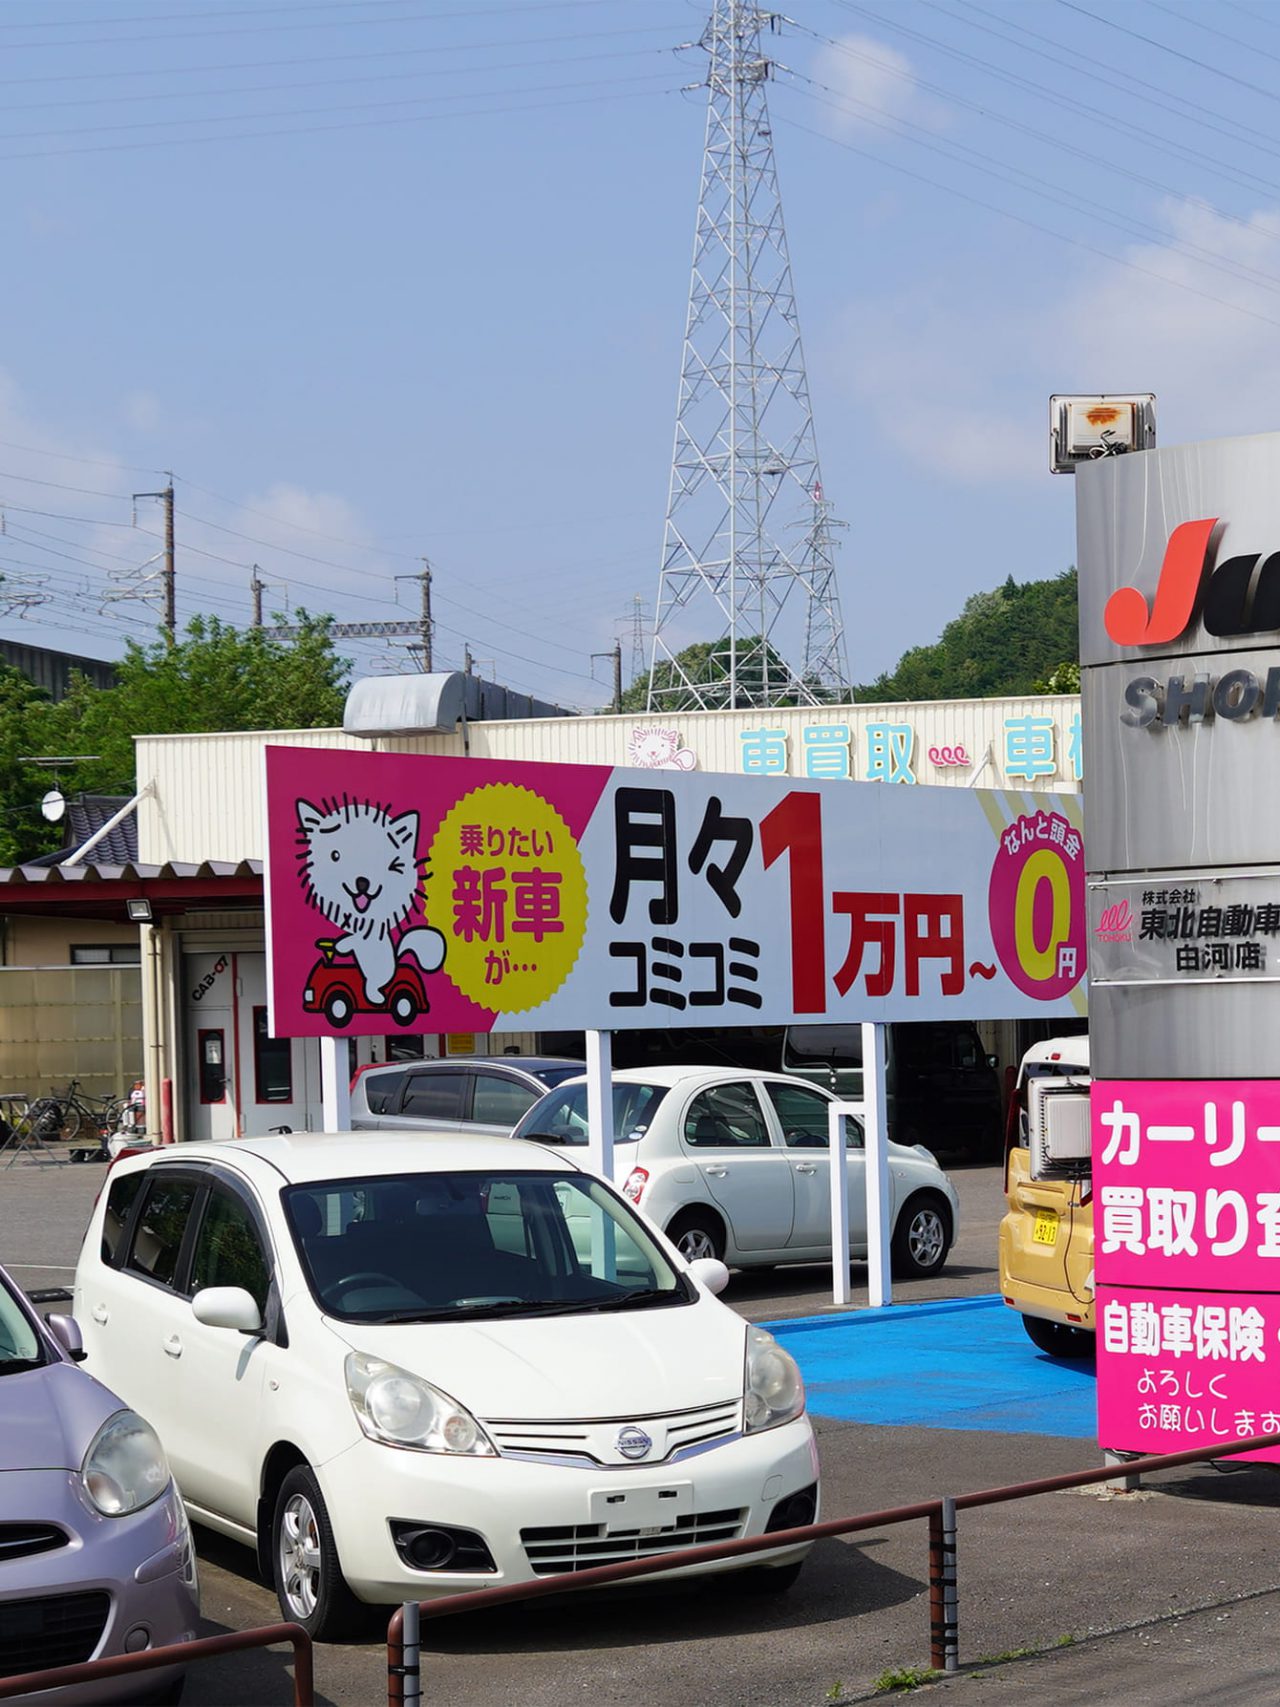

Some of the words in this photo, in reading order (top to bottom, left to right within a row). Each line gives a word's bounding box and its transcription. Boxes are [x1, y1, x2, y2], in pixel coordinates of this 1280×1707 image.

[740, 721, 917, 784] 車買取
[459, 823, 554, 858] 乗りたい
[609, 787, 754, 925] 月々
[1003, 815, 1081, 861] なんと頭金
[452, 865, 565, 944] 新車
[1142, 888, 1197, 906] 株式会社
[608, 937, 763, 1011] コミコミ
[1137, 1367, 1229, 1400] よろしく
[618, 1438, 650, 1446] NISSAN
